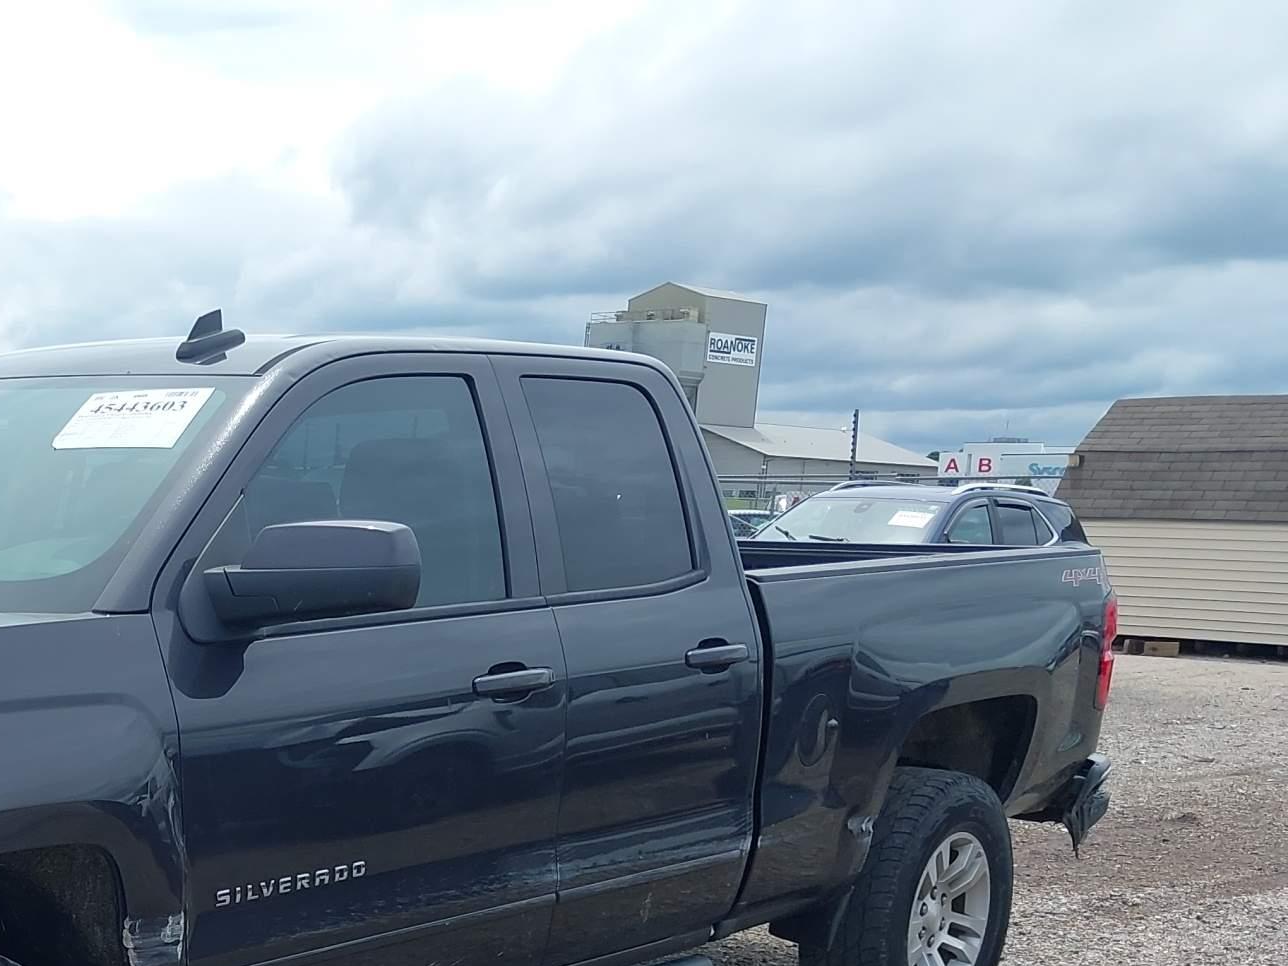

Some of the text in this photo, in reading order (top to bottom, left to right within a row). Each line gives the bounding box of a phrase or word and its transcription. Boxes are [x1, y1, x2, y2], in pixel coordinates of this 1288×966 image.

[710, 337, 755, 354] ROANOKE
[89, 400, 188, 414] 45443603
[944, 458, 960, 473] A
[978, 458, 992, 473] B
[215, 860, 366, 907] SILVERADO
